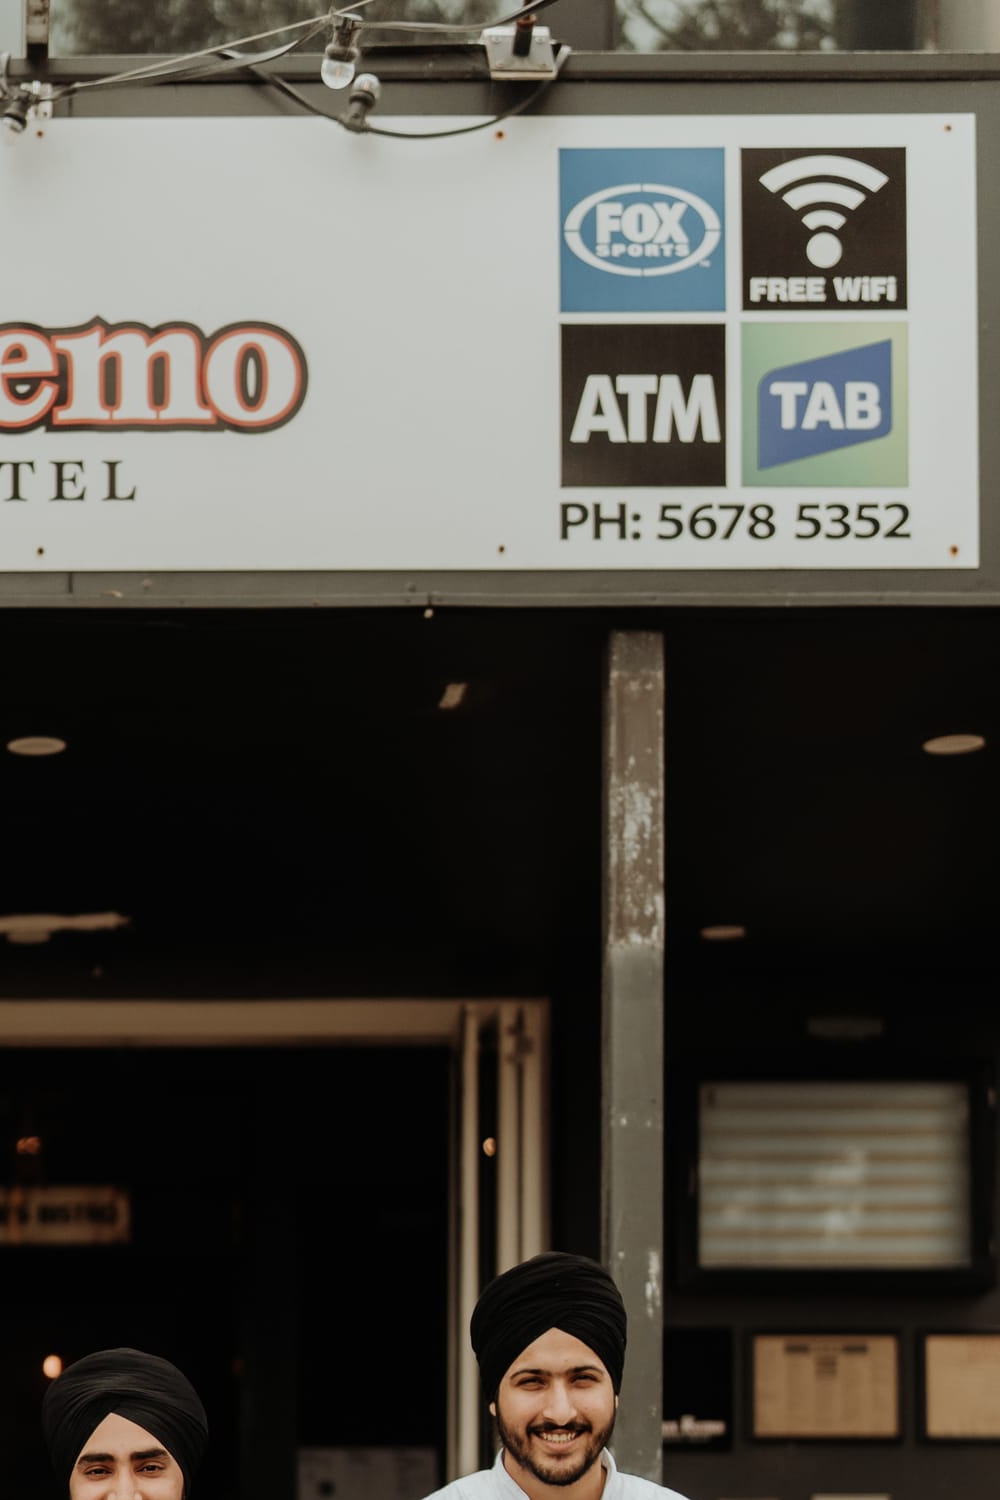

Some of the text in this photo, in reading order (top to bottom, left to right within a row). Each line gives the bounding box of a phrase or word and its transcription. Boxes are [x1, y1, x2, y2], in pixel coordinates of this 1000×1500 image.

[595, 202, 690, 244] FOX
[595, 243, 690, 258] SPORTS
[749, 276, 827, 303] FREE
[569, 374, 721, 444] ATM
[769, 381, 883, 431] TAB
[560, 503, 911, 540] PH: 5678 5352
